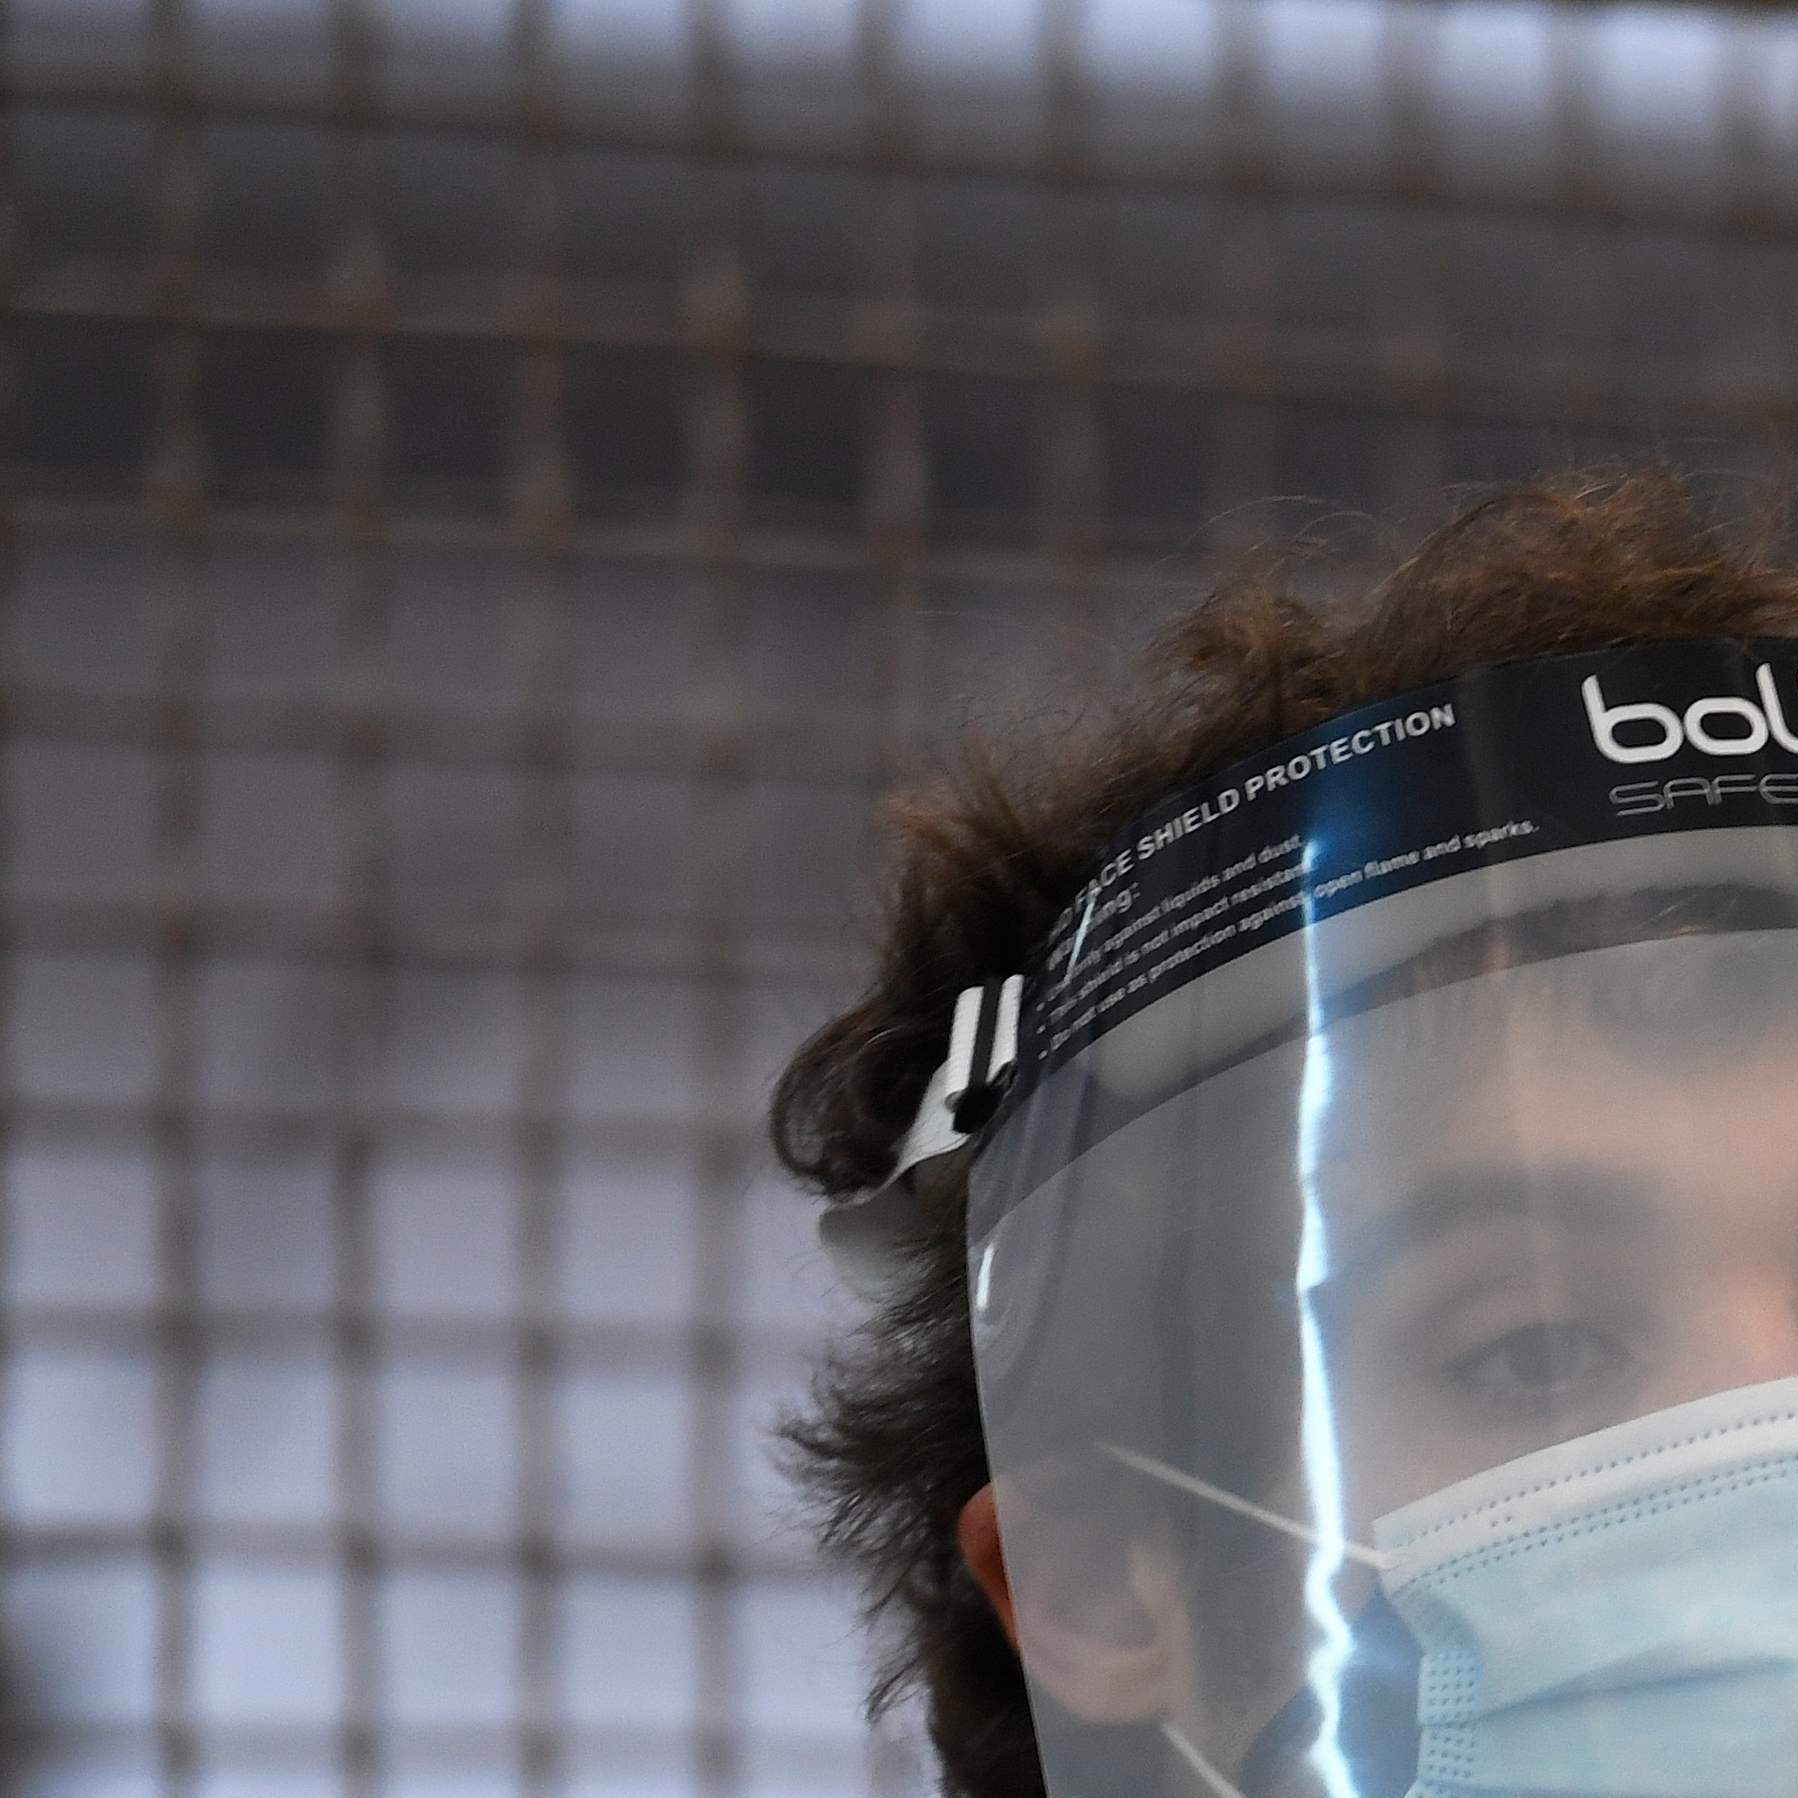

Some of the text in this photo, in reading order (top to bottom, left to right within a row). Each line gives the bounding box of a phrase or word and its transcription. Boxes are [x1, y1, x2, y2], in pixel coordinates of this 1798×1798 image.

[1075, 703, 1456, 913] FACE SHIELD PROTECTION
[1140, 929, 1170, 956] not
[1170, 895, 1230, 938] impact
[1147, 924, 1237, 984] protection
[1313, 870, 1364, 898] open
[1364, 850, 1421, 879] flame
[1422, 835, 1462, 861] and
[1463, 819, 1540, 850] sparks.
[1161, 874, 1220, 914] liquids
[1221, 853, 1257, 882] and
